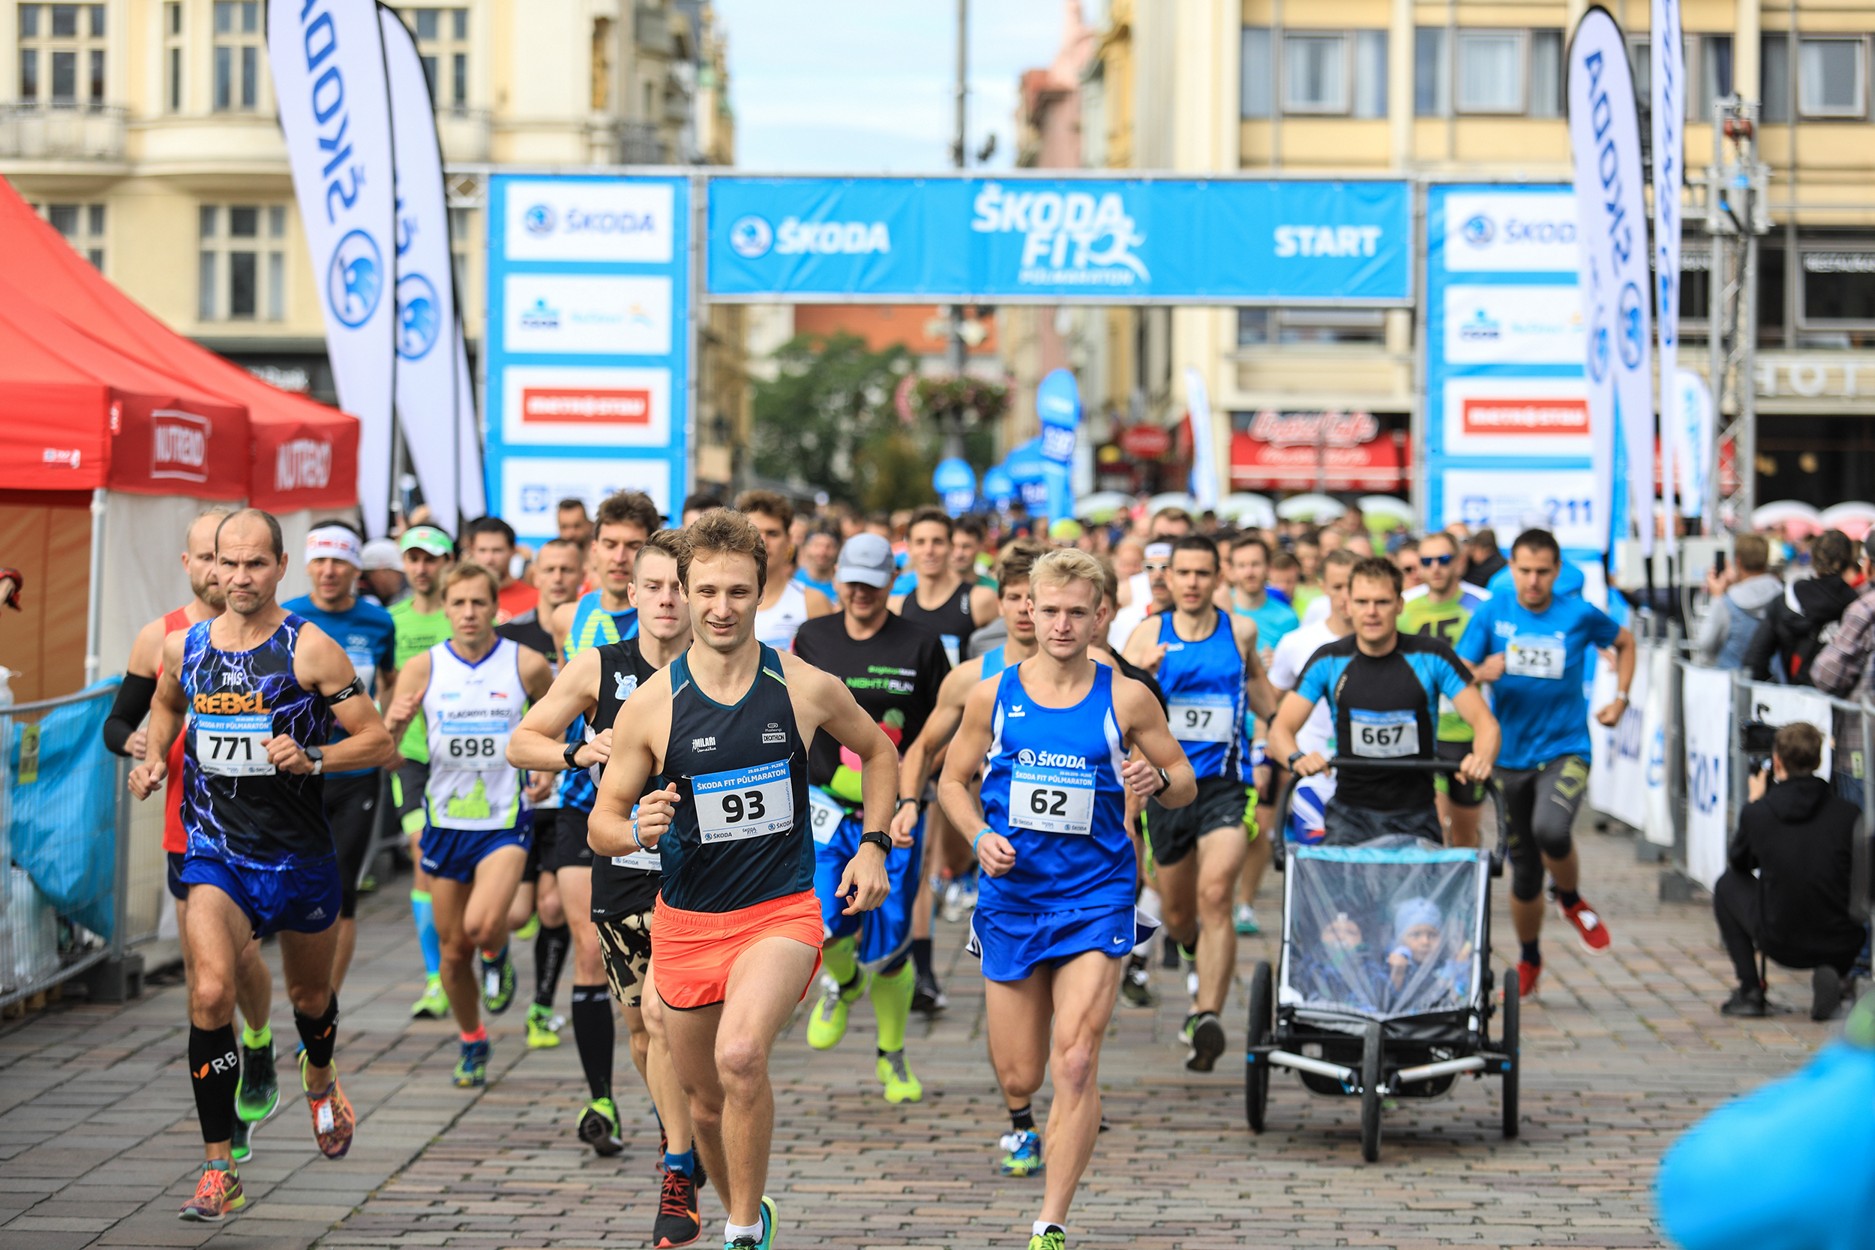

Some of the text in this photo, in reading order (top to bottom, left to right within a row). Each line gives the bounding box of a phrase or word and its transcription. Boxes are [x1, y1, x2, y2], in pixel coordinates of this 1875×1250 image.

[971, 183, 1126, 233] ŠKODA
[563, 208, 656, 235] ŠKODA
[1503, 218, 1577, 244] ŠKOD
[775, 215, 891, 255] ŠKODA
[1273, 224, 1383, 258] START
[1020, 230, 1096, 269] FIT
[155, 424, 206, 467] NUTREND
[1544, 496, 1593, 526] 211
[1517, 649, 1552, 667] 525
[222, 671, 243, 686] THIS
[889, 679, 914, 692] RUN
[193, 691, 272, 715] REBEL
[1185, 709, 1213, 729] 97
[449, 737, 496, 757] 698
[1361, 725, 1404, 746] 667
[209, 736, 252, 760] 771
[1036, 750, 1087, 770] ŠKODA
[696, 769, 787, 791] ŠKODA FIT PŮLMARATON
[1015, 770, 1036, 780] ŠKODA
[1048, 774, 1093, 786] PŮLMARATON
[721, 790, 766, 823] 93
[1030, 788, 1068, 816] 62
[622, 858, 639, 866] ŠKODA
[211, 1050, 238, 1075] RB
